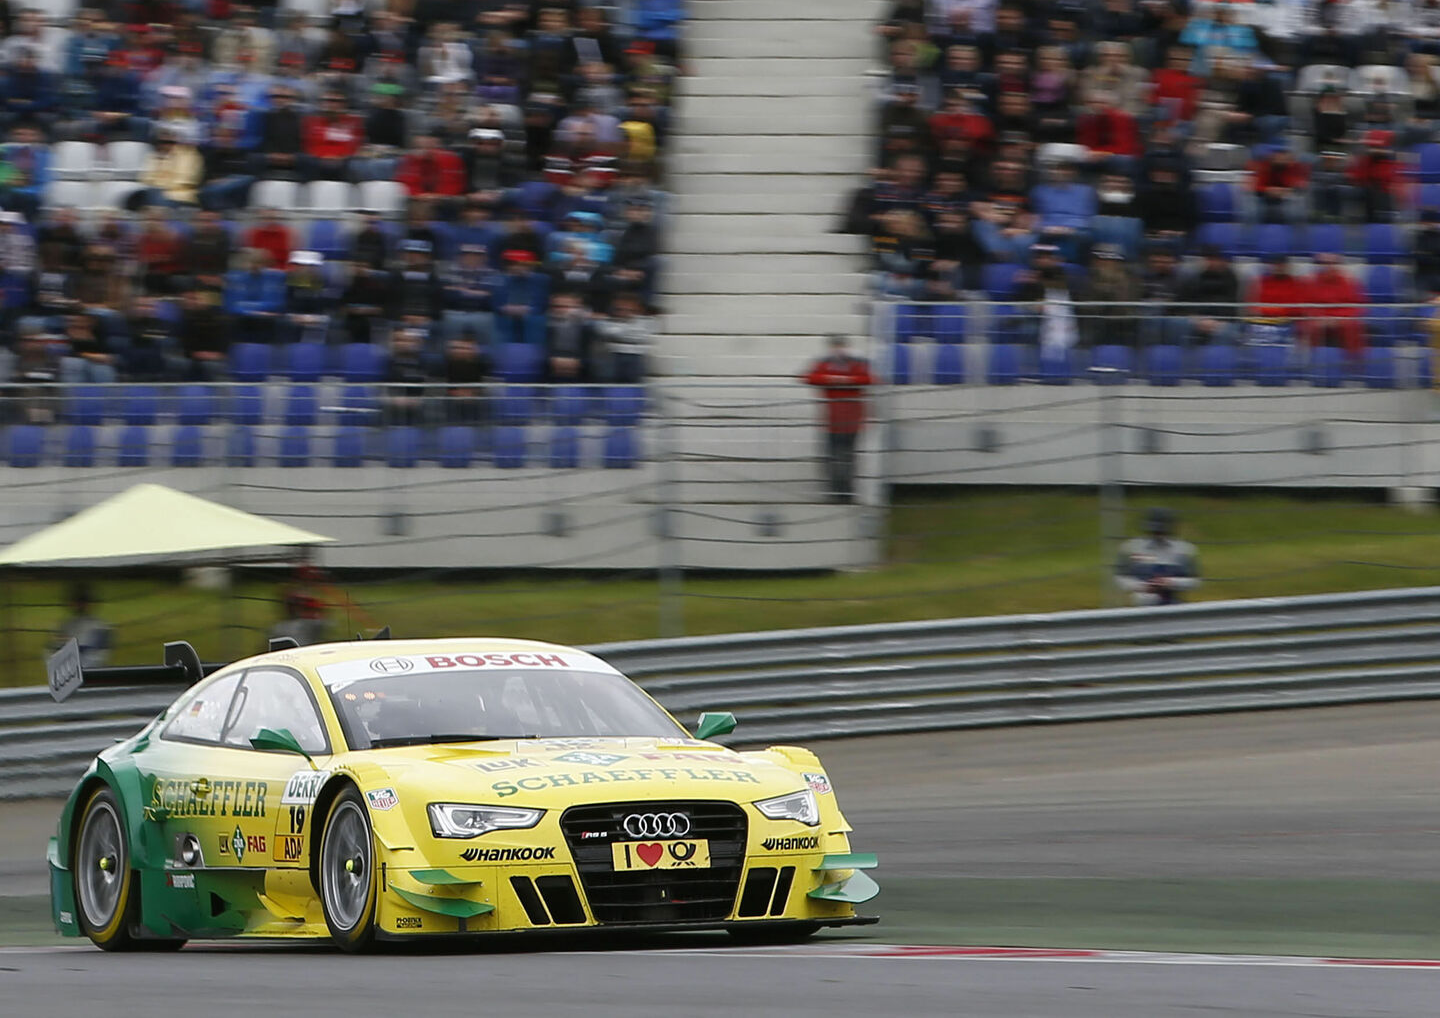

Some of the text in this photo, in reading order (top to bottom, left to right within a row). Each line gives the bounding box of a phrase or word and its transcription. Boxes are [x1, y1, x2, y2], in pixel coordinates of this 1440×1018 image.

[424, 654, 570, 669] BOSCH
[491, 769, 761, 797] SCHAEFFLER
[152, 779, 268, 817] SCHAEFFLER
[289, 805, 305, 834] 19
[247, 836, 266, 853] FAG
[624, 844, 632, 868] I
